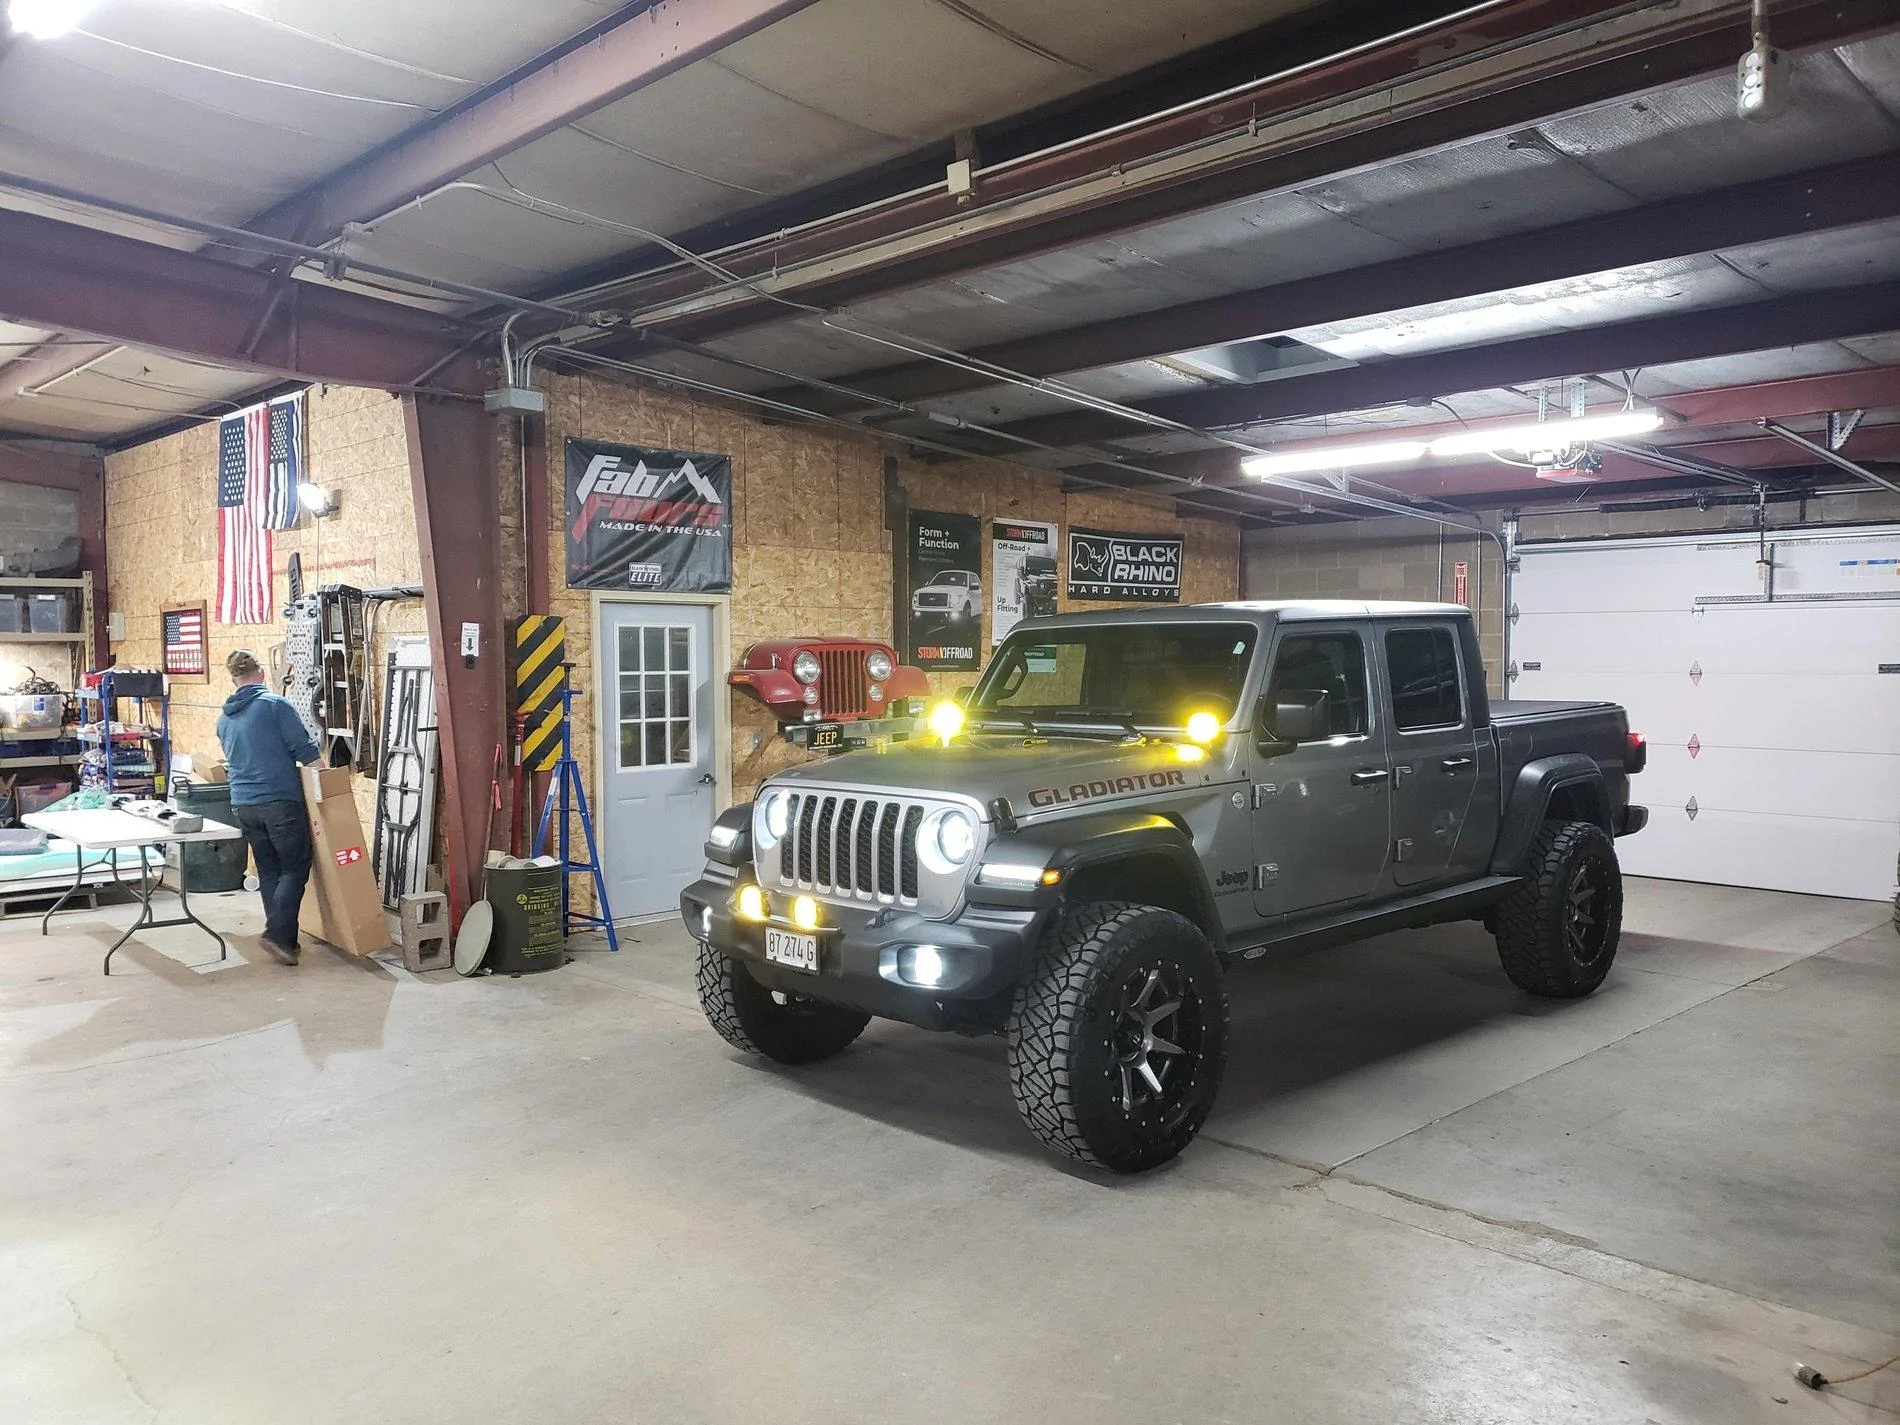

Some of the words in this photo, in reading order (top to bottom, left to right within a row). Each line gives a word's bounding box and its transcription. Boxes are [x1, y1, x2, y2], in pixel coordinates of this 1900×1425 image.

[575, 454, 659, 505] Fab
[599, 520, 645, 532] MADE
[648, 524, 662, 533] IN
[665, 525, 693, 535] THE
[695, 527, 723, 537] USA
[919, 526, 942, 538] Form
[919, 537, 960, 550] Function
[997, 542, 1026, 552] Off-Road
[1112, 544, 1178, 563] BLACK
[630, 572, 661, 583] ELITE
[1114, 563, 1175, 582] RHINO
[1068, 585, 1111, 595] HARD
[1122, 588, 1179, 597] ALLOYS
[997, 596, 1007, 606] Up
[997, 604, 1019, 614] Fitting
[813, 731, 838, 746] JEEP
[1027, 769, 1186, 808] GLADIATOR
[1216, 870, 1249, 887] Jeep
[769, 932, 781, 955] 87
[784, 935, 803, 960] 274
[806, 940, 814, 962] G
